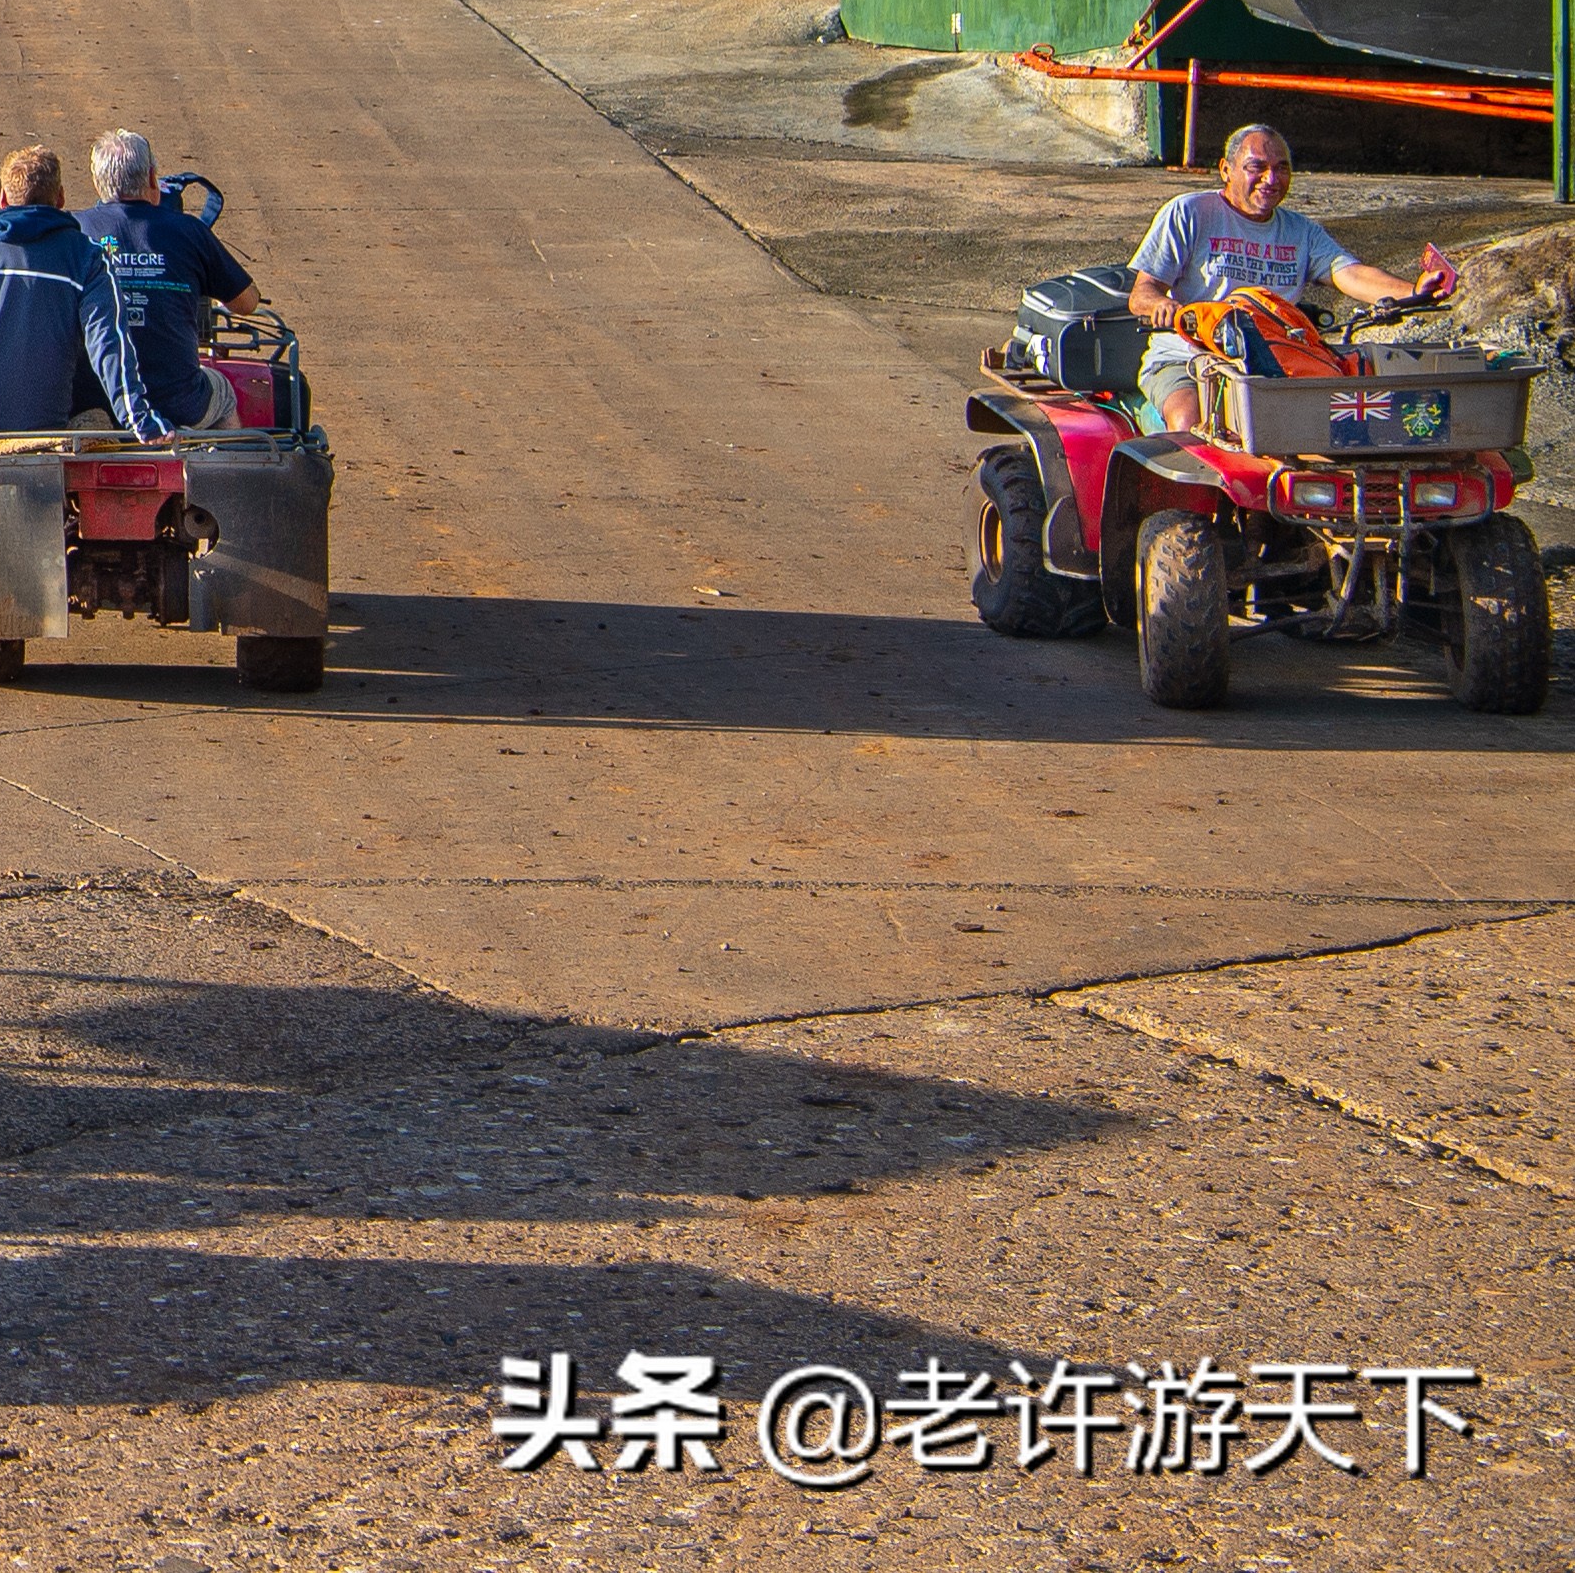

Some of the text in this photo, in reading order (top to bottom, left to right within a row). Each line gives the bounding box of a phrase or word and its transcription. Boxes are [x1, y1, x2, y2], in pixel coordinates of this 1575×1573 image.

[1209, 237, 1243, 254] WENT
[1245, 241, 1260, 258] ON
[1263, 243, 1272, 259] A
[1223, 253, 1244, 267] WAS
[1246, 257, 1264, 272] THE
[1266, 261, 1298, 274] WORST
[1216, 265, 1247, 282] HOURS
[1259, 273, 1276, 287] MY
[1277, 274, 1298, 287] LIFE
